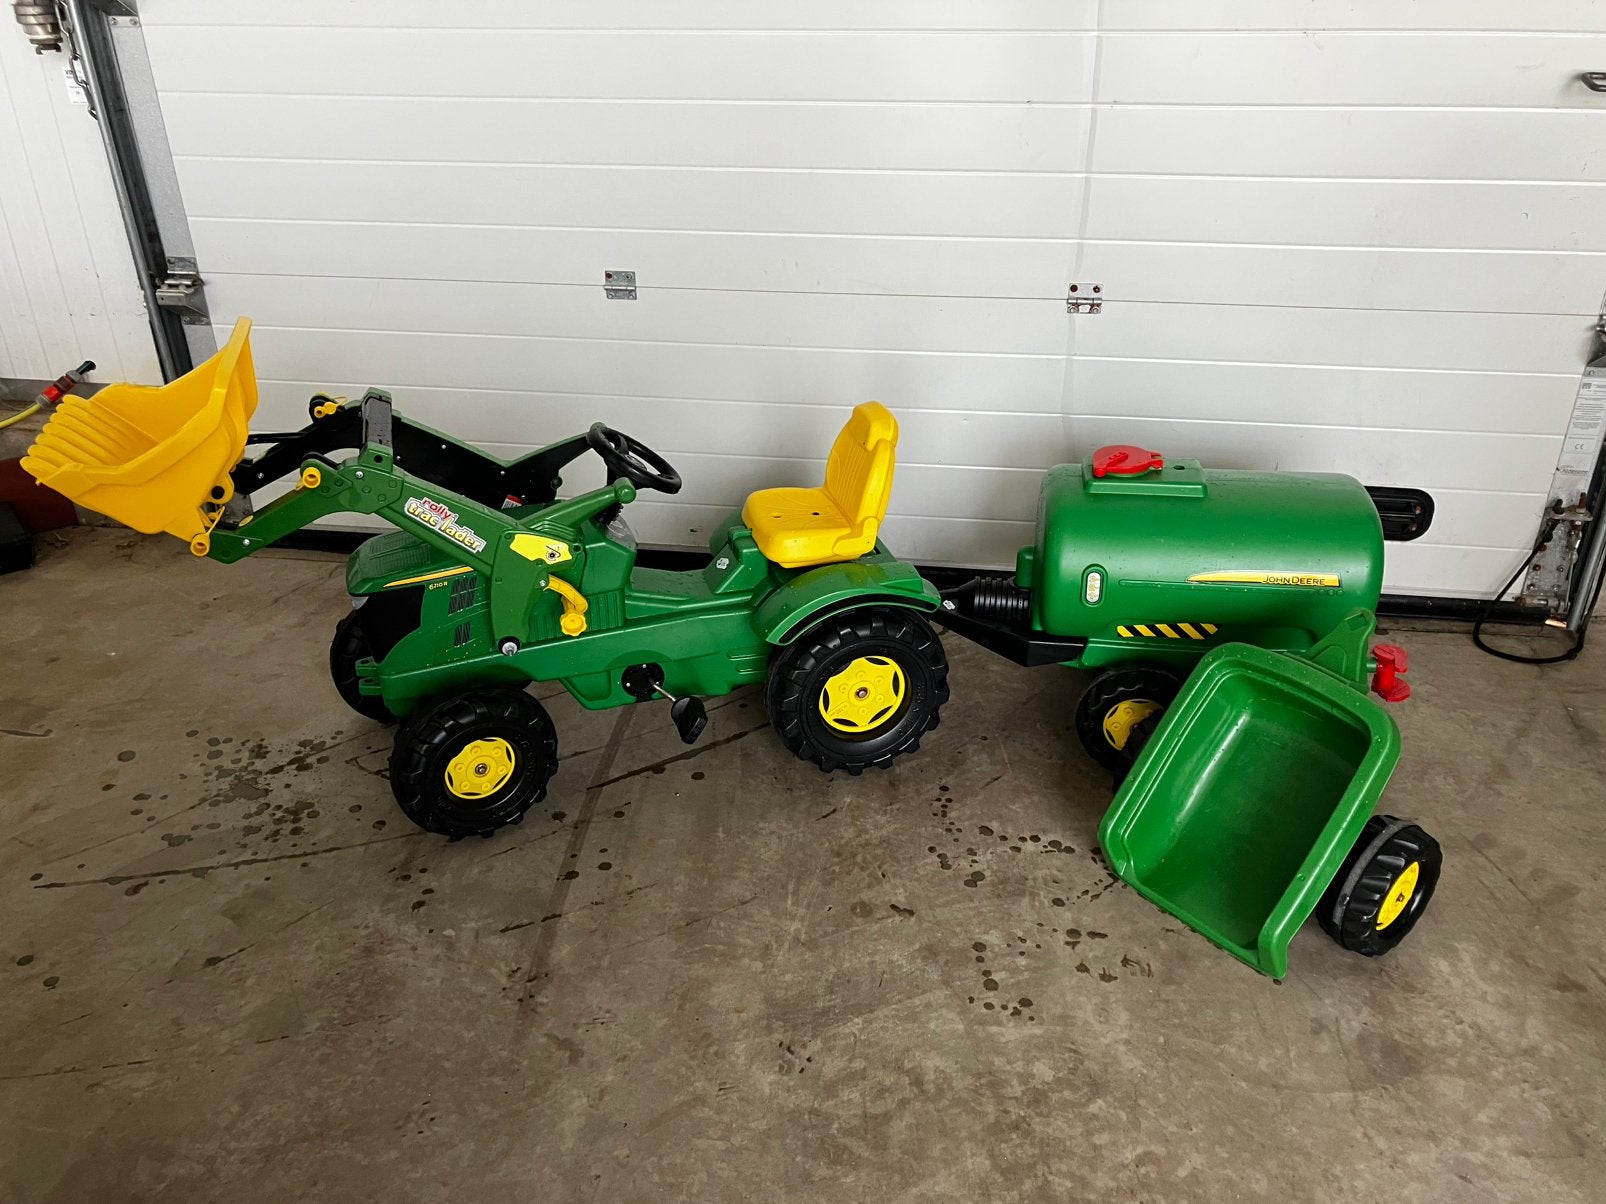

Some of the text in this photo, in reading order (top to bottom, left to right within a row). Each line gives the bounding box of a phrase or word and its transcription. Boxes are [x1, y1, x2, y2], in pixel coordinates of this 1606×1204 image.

[422, 499, 452, 520] rolly
[407, 502, 481, 550] trac lader
[1262, 574, 1326, 586] JOHN DEERE
